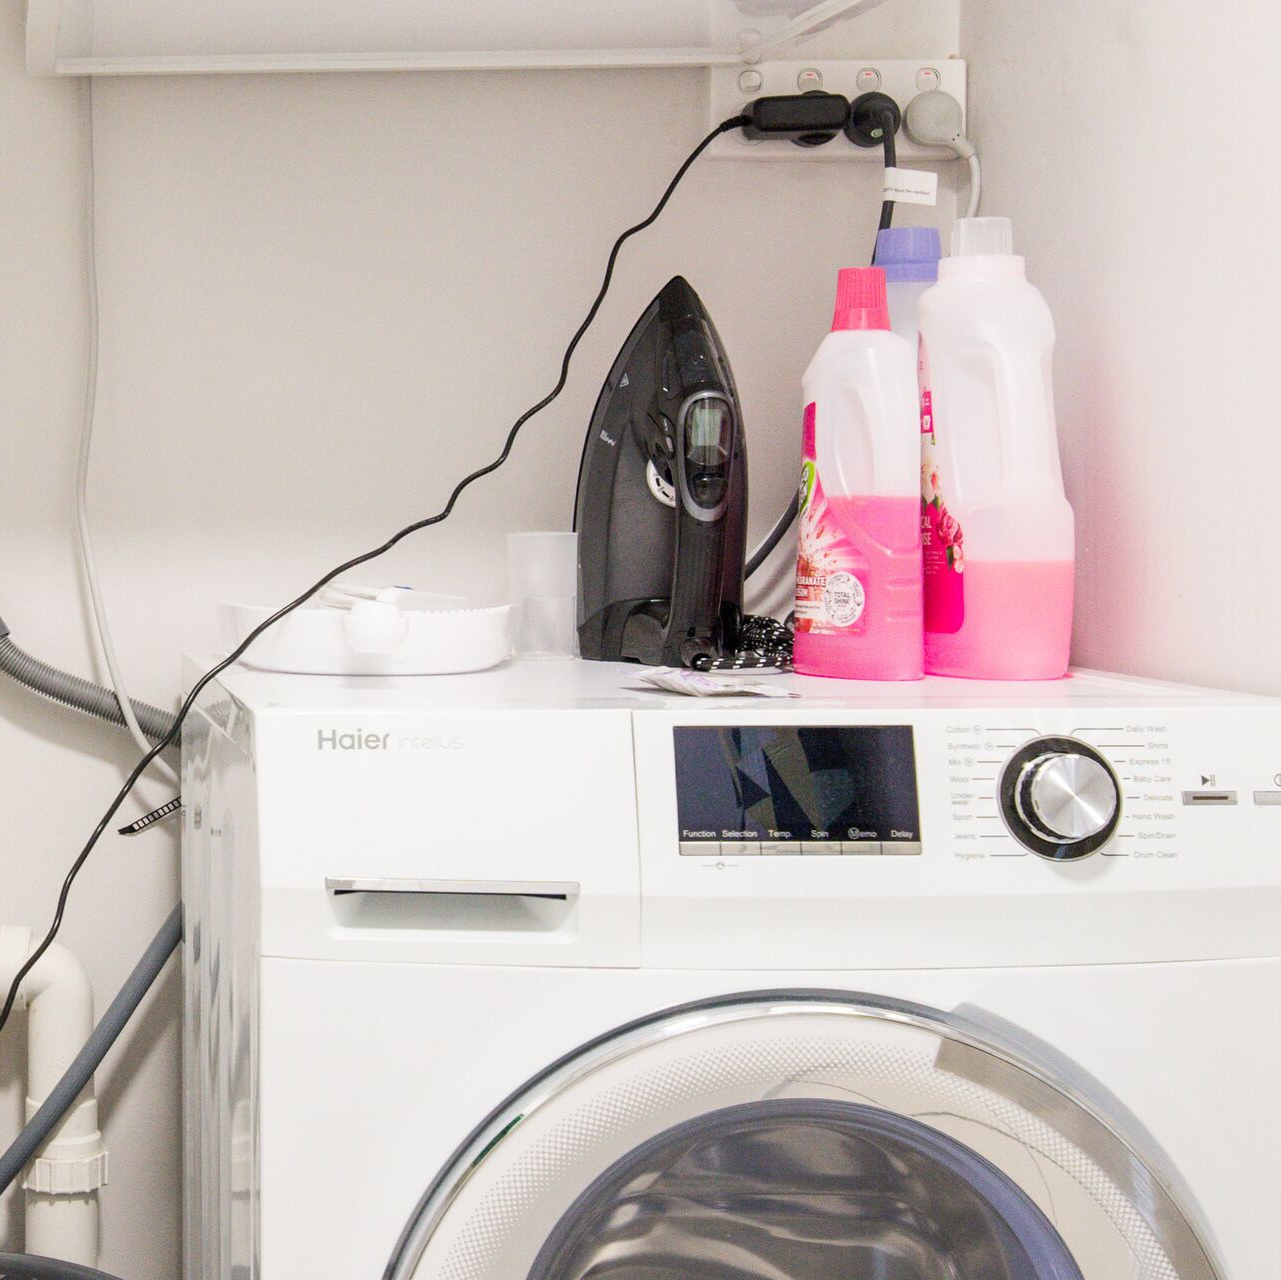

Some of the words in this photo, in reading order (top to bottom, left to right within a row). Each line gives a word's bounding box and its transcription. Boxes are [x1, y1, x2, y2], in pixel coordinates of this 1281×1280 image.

[1126, 725, 1144, 734] Daily
[318, 728, 390, 750] Haier
[947, 743, 981, 751] Synthetic
[1147, 742, 1169, 750] Shirts
[1129, 758, 1159, 766] Express
[1133, 775, 1152, 783] Baby
[952, 813, 973, 821] Sport
[682, 829, 717, 838] Function
[722, 829, 758, 838] Selection
[768, 829, 793, 839] Temp.
[811, 829, 829, 839] Spin
[891, 830, 913, 840] Delay
